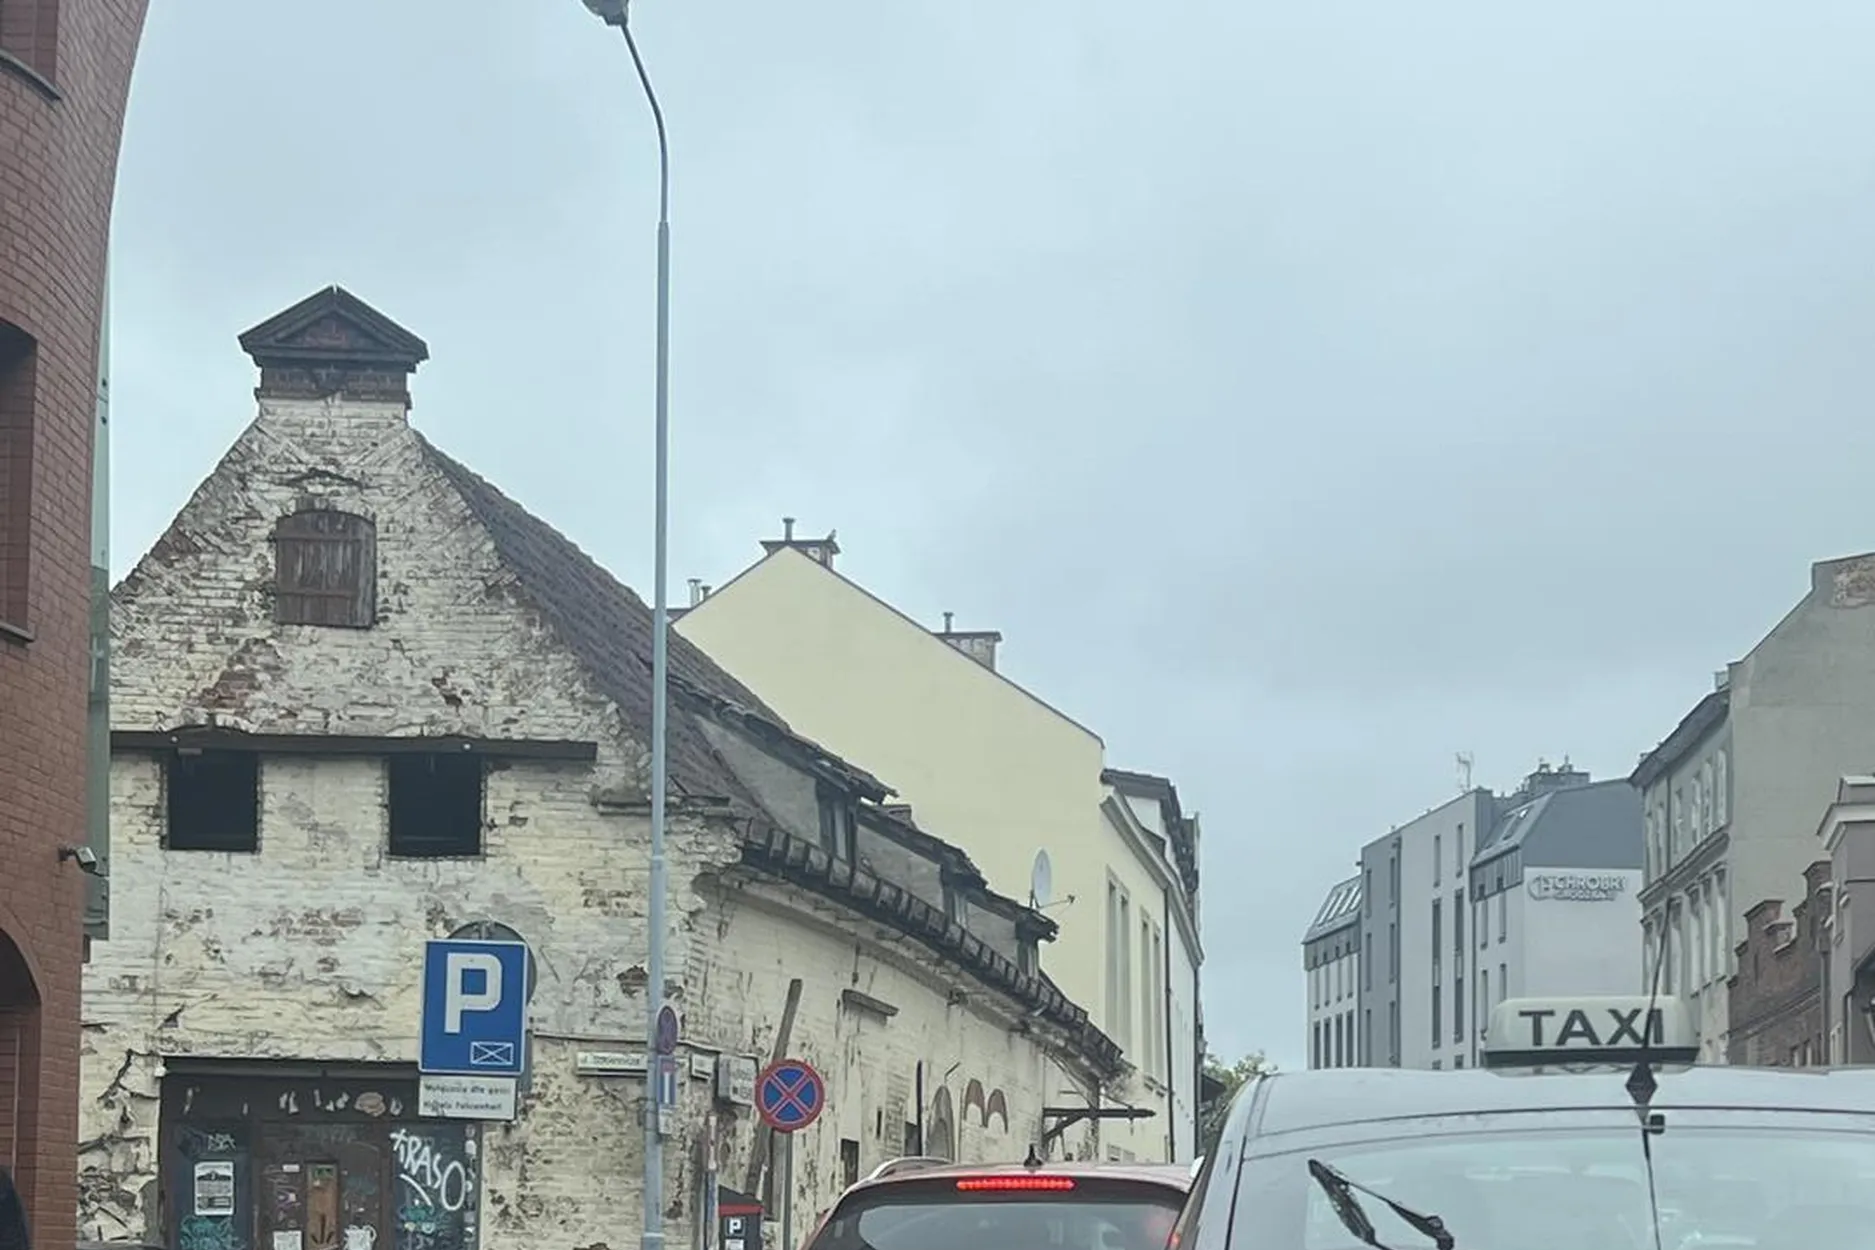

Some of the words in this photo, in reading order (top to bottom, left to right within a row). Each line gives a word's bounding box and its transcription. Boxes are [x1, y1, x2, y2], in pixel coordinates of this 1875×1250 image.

[444, 952, 502, 1034] P
[1518, 1007, 1665, 1047] TAXI
[729, 1218, 742, 1234] P
